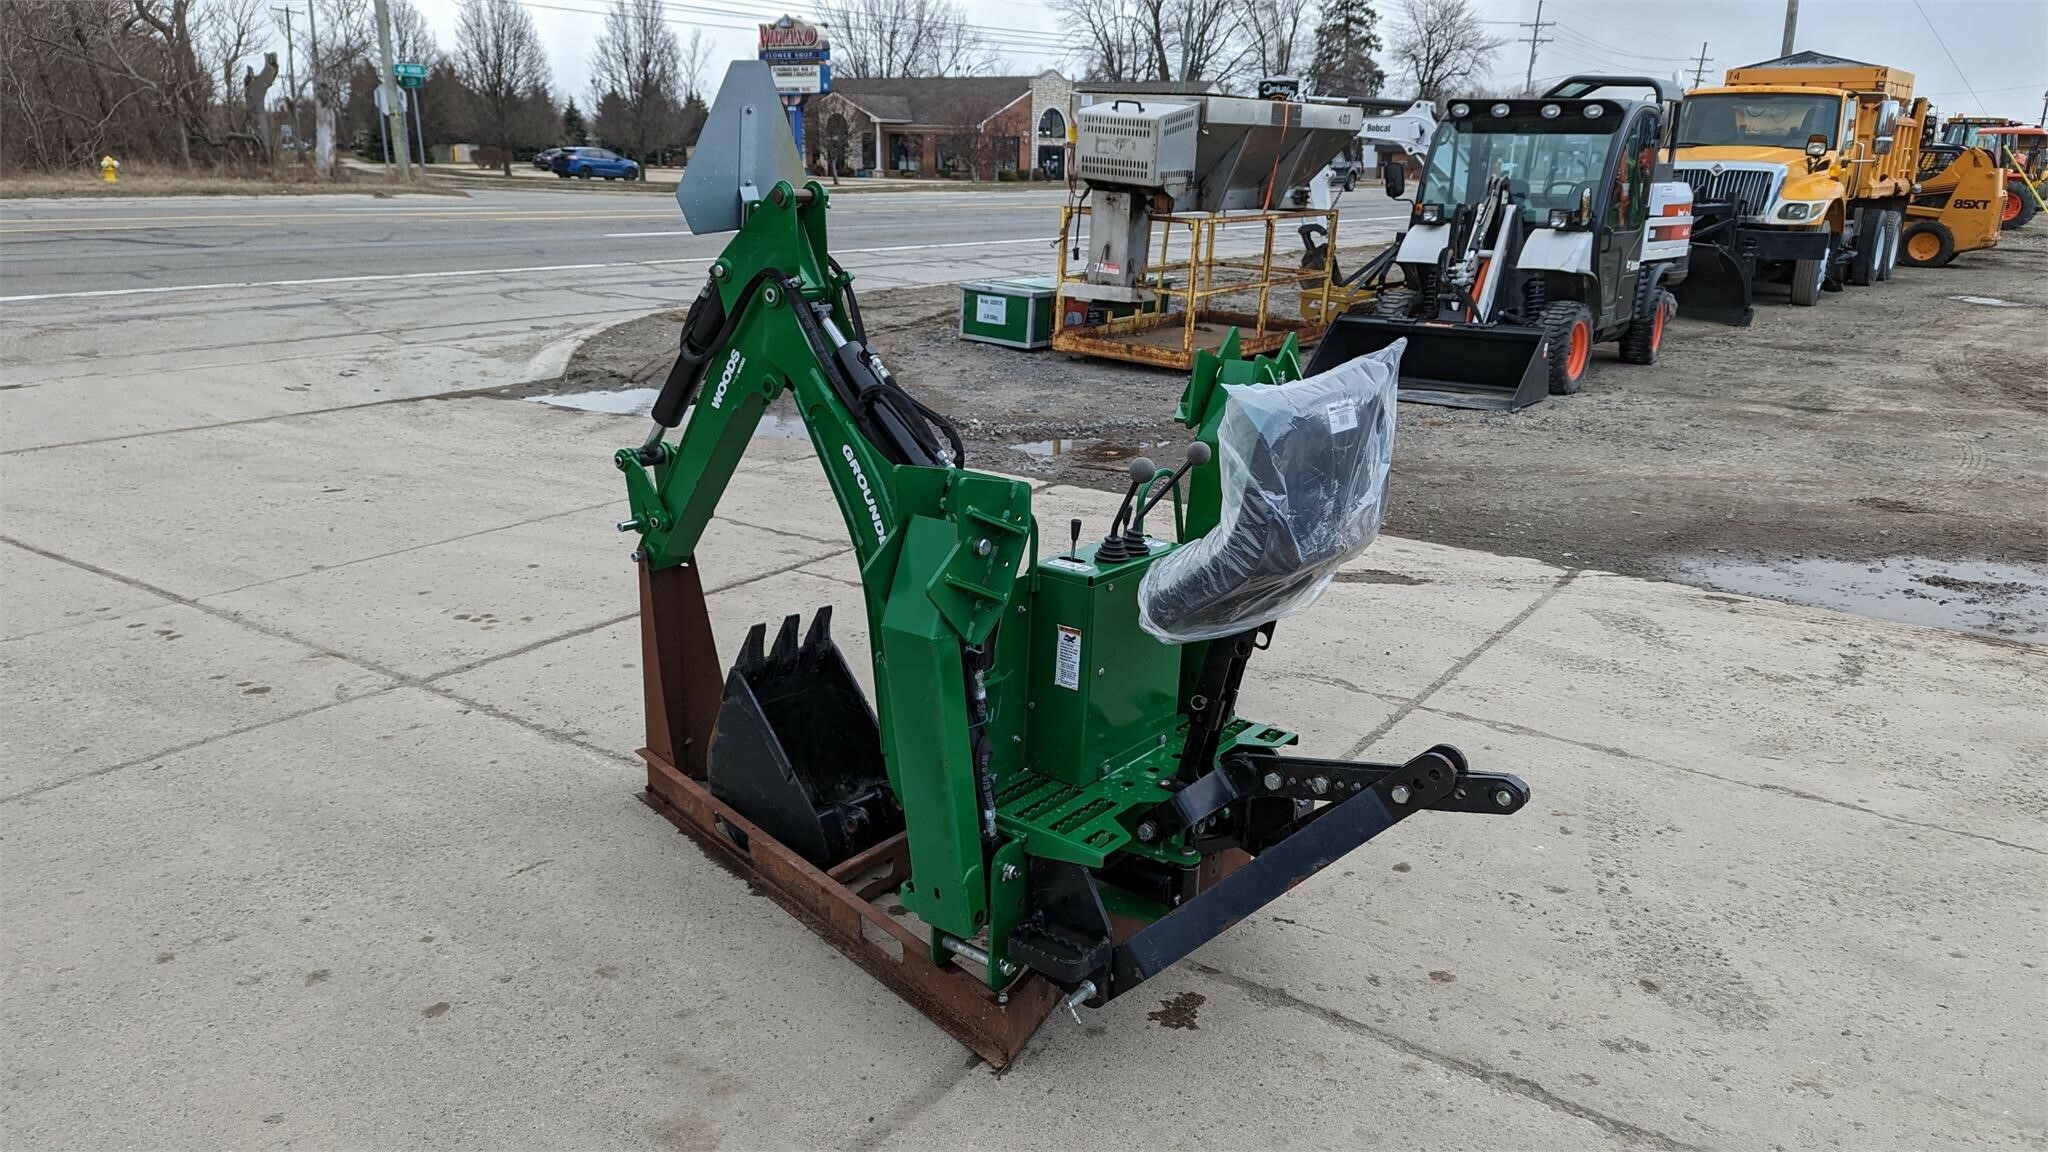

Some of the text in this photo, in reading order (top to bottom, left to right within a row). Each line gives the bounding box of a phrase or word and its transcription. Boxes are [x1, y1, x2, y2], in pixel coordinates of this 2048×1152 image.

[1338, 113, 1351, 125] 403
[1367, 123, 1391, 132] Bobcat
[1953, 199, 1991, 210] 85XT
[711, 348, 740, 409] WOODS
